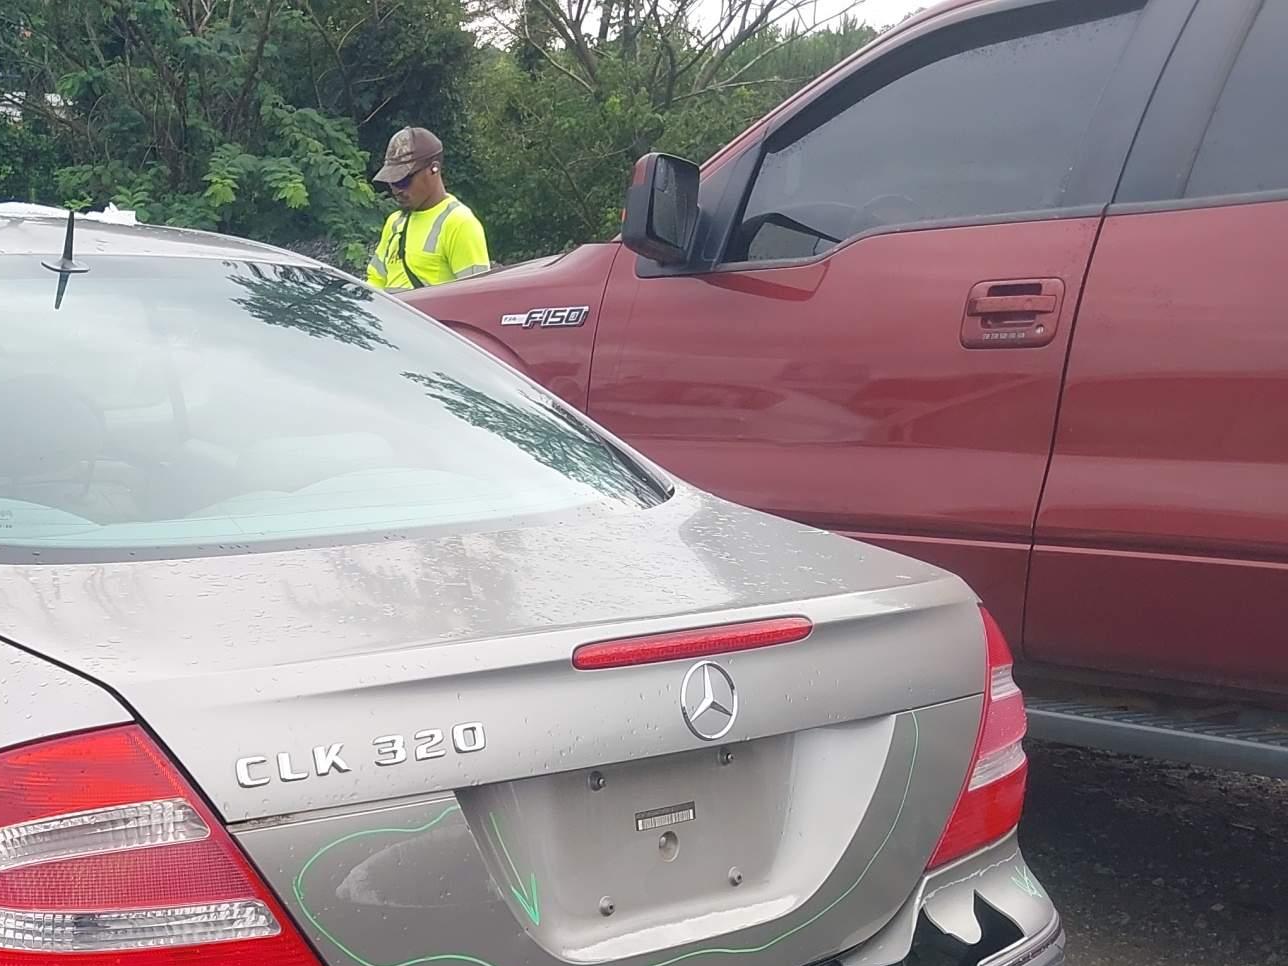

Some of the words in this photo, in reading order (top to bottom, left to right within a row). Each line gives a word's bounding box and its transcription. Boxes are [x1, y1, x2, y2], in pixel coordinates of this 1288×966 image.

[523, 306, 589, 327] F-150
[235, 743, 352, 788] CLK
[372, 722, 486, 766] 320
